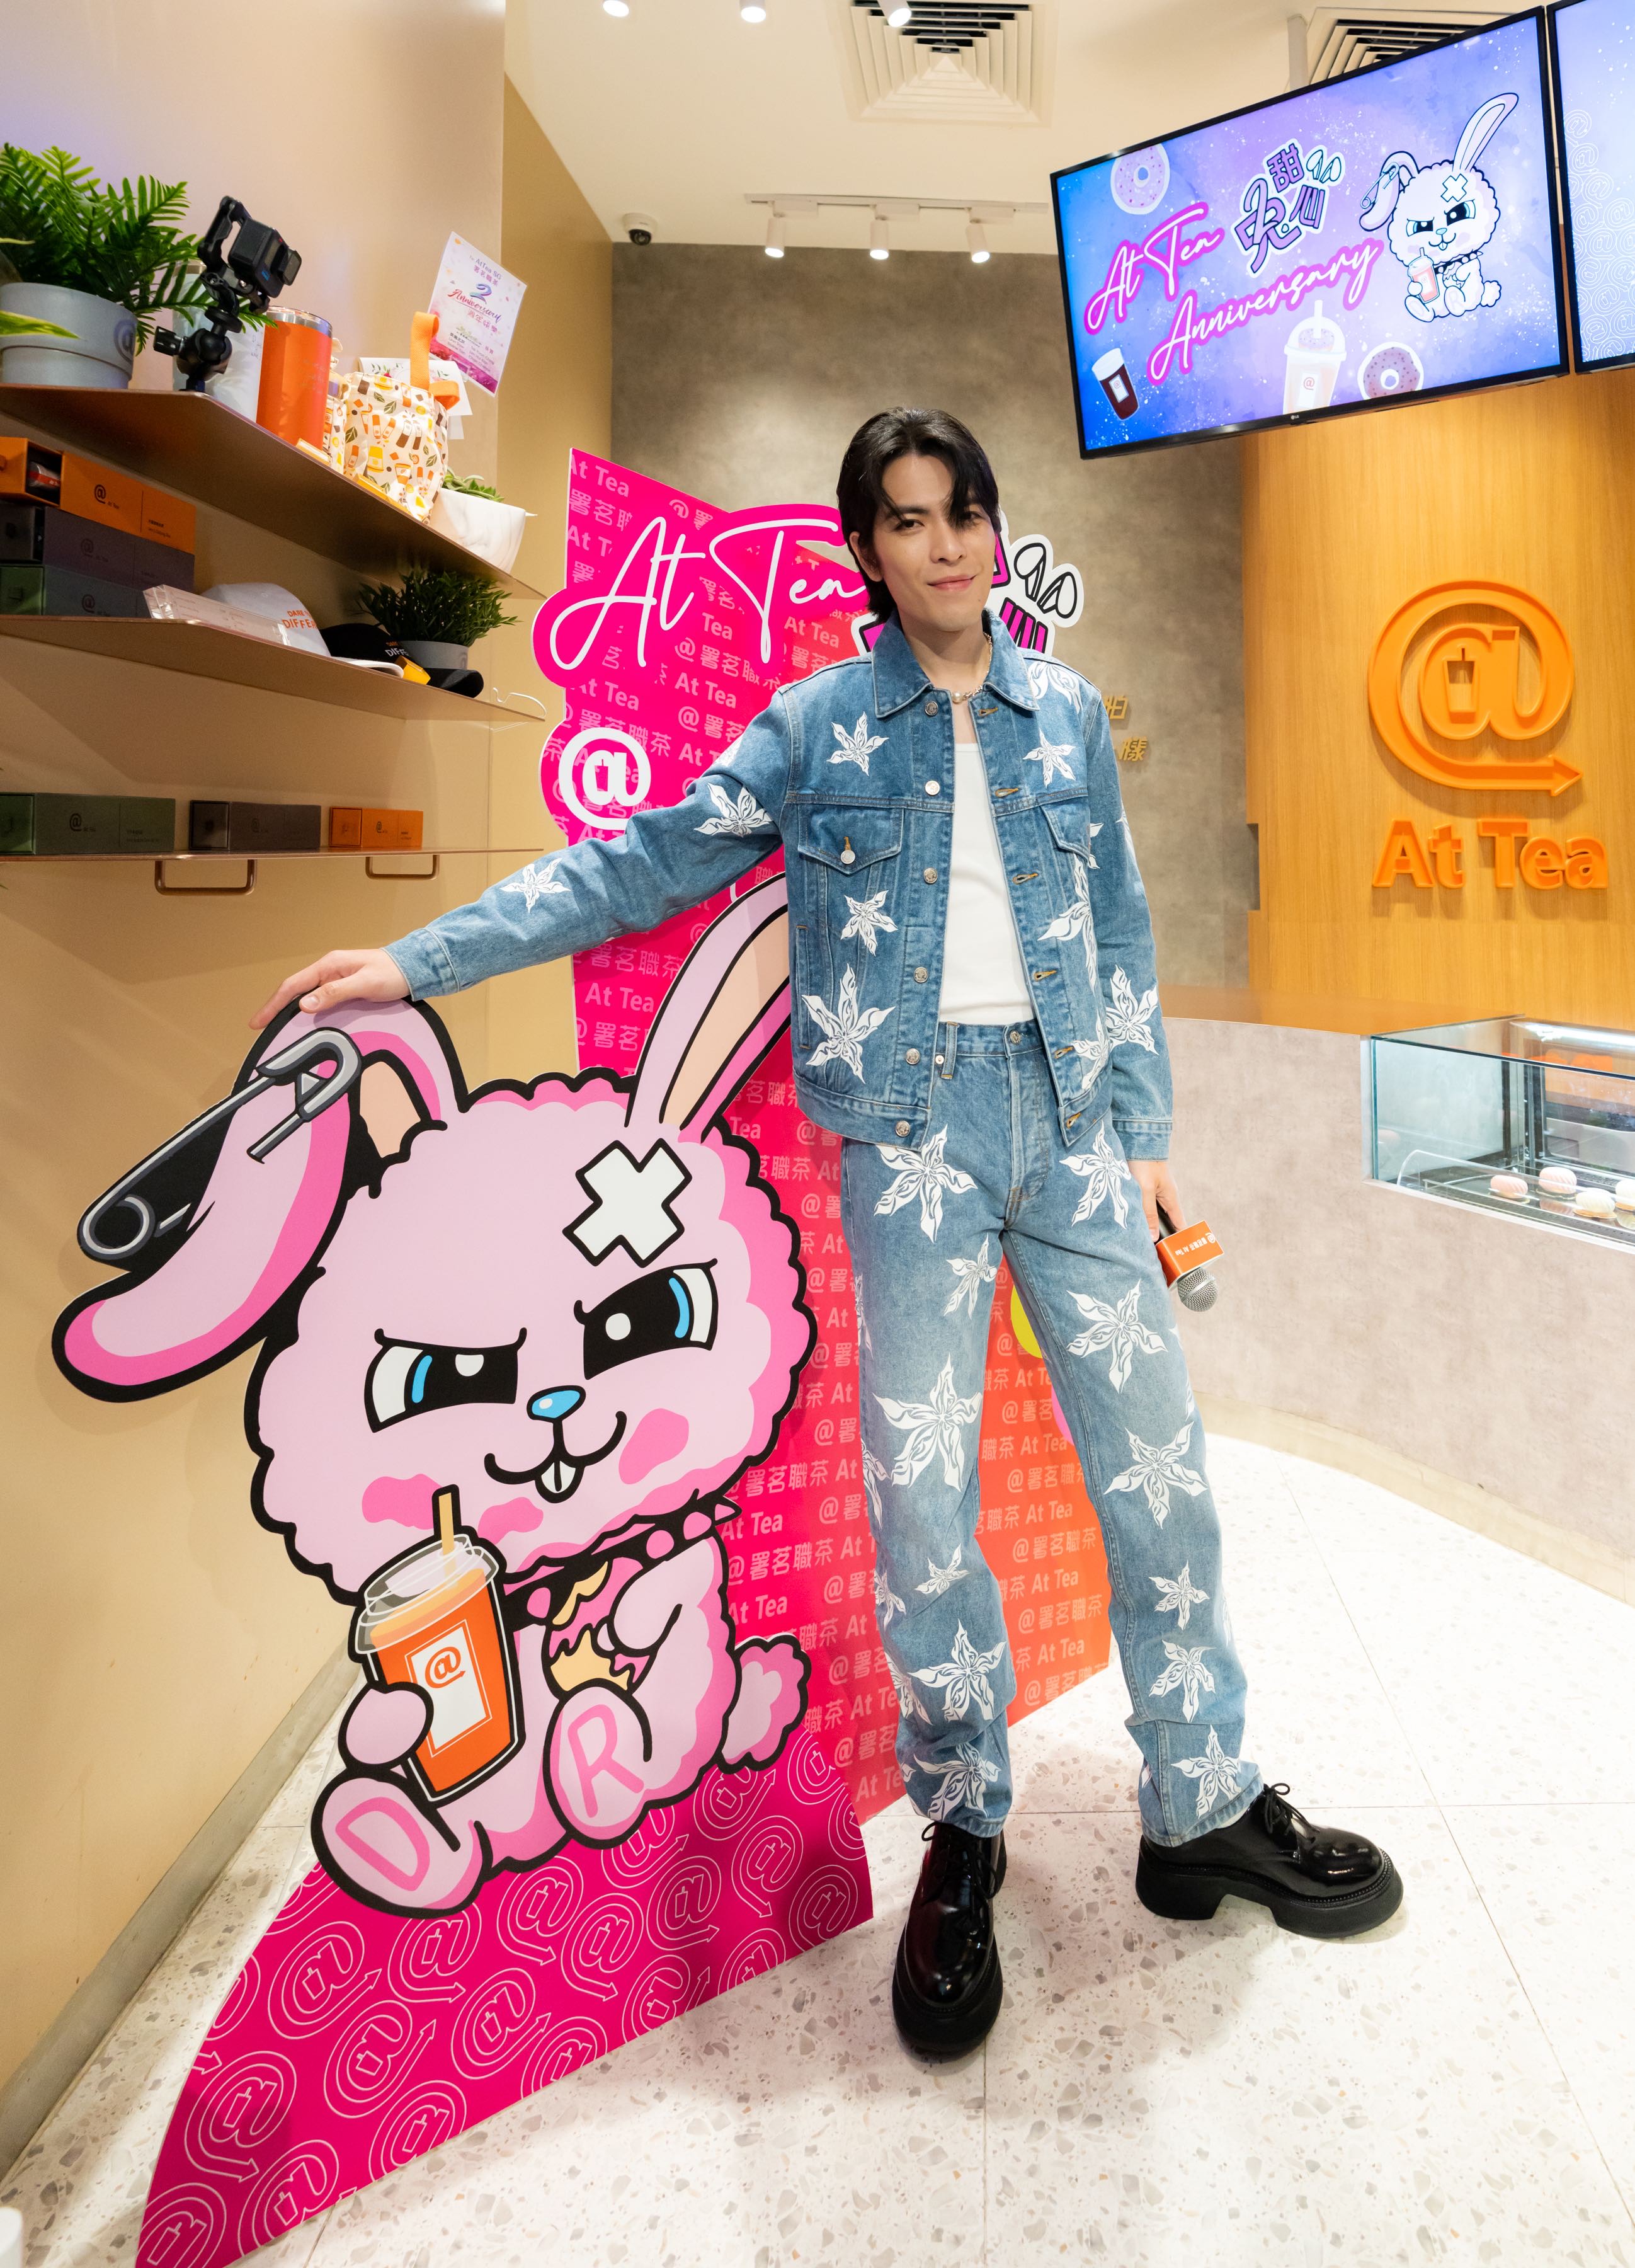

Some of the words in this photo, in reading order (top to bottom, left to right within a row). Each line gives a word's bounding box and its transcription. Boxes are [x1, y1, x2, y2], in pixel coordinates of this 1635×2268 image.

[1088, 246, 1145, 329] At
[1143, 208, 1221, 297] Tea
[469, 284, 493, 305] 2
[1150, 243, 1379, 380] Anniversary
[595, 465, 629, 498] Tea
[567, 525, 591, 551] At
[549, 516, 706, 670] At
[702, 612, 733, 641] Tea
[783, 616, 806, 636] At
[811, 621, 840, 649] Tea
[604, 680, 640, 711] Tea
[675, 672, 699, 696] At
[705, 680, 737, 709] Tea
[678, 706, 700, 733] @
[678, 742, 704, 767] At
[1372, 819, 1466, 888] At
[1477, 818, 1609, 890] Tea
[584, 982, 612, 1007] At
[619, 987, 655, 1013] Tea
[729, 1116, 761, 1140] Tea
[817, 1160, 841, 1181] At
[800, 1193, 821, 1219] @
[821, 1233, 843, 1254] At
[826, 1307, 848, 1329] At
[996, 1332, 1013, 1357] @
[1015, 1368, 1034, 1389] At
[831, 1382, 853, 1404] At
[1001, 1400, 1018, 1424] @
[814, 1418, 835, 1446] @
[1020, 1435, 1039, 1456] At
[1043, 1433, 1068, 1452] Tea
[835, 1458, 858, 1481] At
[1007, 1468, 1024, 1493] @
[750, 1511, 783, 1537] Tea
[819, 1496, 839, 1525] @
[1025, 1503, 1044, 1526] At
[1047, 1500, 1073, 1520] Tea
[840, 1535, 863, 1560] At
[1012, 1538, 1030, 1564] @
[1033, 1526, 1097, 1560] 署茗職茶
[824, 1575, 844, 1605] @
[1030, 1573, 1050, 1595] At
[1054, 1568, 1079, 1589] Tea
[755, 1594, 788, 1620] Tea
[1018, 1608, 1035, 1634] @
[1039, 1593, 1103, 1630] 署茗職茶
[845, 1614, 868, 1639] At
[1037, 1644, 1056, 1666] At
[1059, 1637, 1085, 1659] Tea
[828, 1655, 850, 1686] @
[850, 1694, 873, 1721] At
[878, 1686, 899, 1710] Te
[1024, 1680, 1041, 1707] @
[567, 1704, 645, 1818] R
[834, 1737, 854, 1768] @
[855, 1775, 878, 1802] At
[334, 1797, 431, 1892] D
